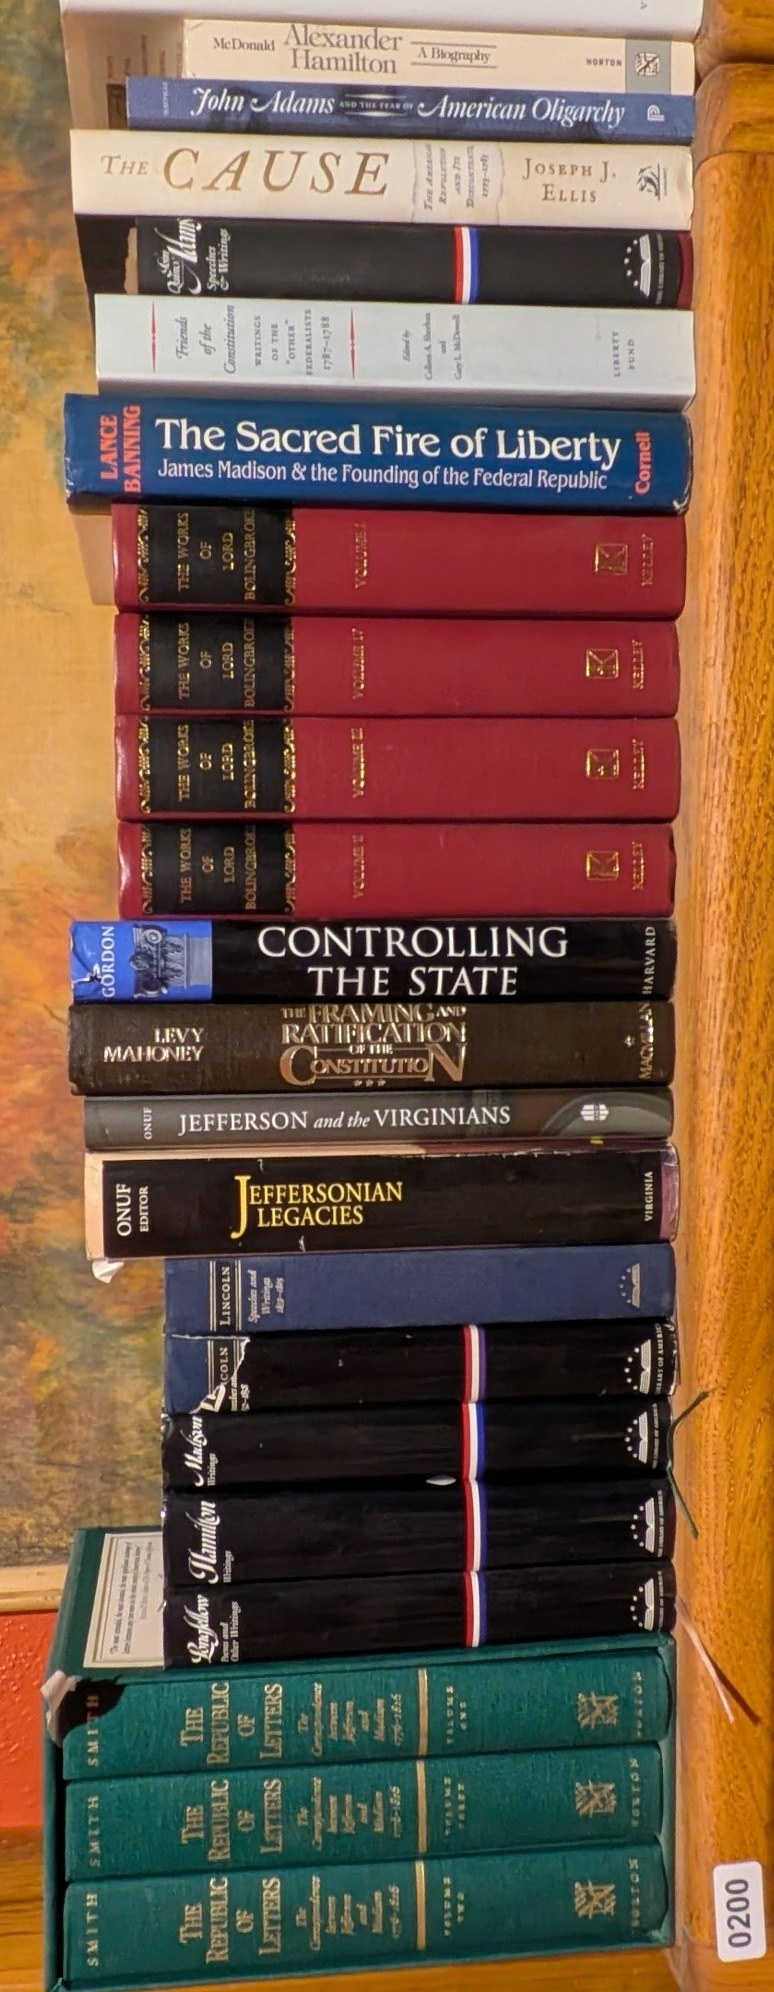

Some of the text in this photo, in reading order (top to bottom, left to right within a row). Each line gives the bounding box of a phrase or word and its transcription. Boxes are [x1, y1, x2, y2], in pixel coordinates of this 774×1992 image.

[213, 37, 276, 52] McDonald
[284, 23, 404, 51] Alexander
[418, 46, 491, 64] A Biography
[291, 48, 397, 74] Hamilton
[586, 58, 622, 67] NORTON
[191, 88, 336, 115] John Adams
[418, 94, 626, 128] American Oligarchy
[101, 148, 389, 195] THE CAUSE
[522, 158, 617, 183] JOSEPH J.
[542, 184, 598, 203] ELLIS
[205, 245, 220, 291] Speeches
[218, 228, 231, 274] Writings
[174, 316, 190, 360] Friends
[198, 324, 217, 356] of the
[222, 304, 237, 374] Constitution
[254, 314, 262, 368] WRITINGS
[270, 322, 279, 362] OF THE
[304, 308, 314, 376] FEDERALISTS
[611, 331, 620, 378] LIBERTY
[627, 338, 636, 370] FUND
[100, 414, 118, 480] LANCE
[123, 405, 141, 492] BANNING
[154, 418, 622, 470] The Sacred Fire of Liberty
[634, 431, 651, 494] Cornell
[158, 458, 608, 492] James Madison & the Founding of the Federal Republic
[176, 512, 190, 592] THE WORKS
[199, 540, 212, 560] OF
[222, 532, 234, 571] LORD
[354, 532, 367, 590] VOLUME
[641, 533, 654, 586] KELLEY
[177, 622, 190, 700] THE WORKS
[200, 650, 212, 670] OF
[222, 642, 234, 680] LORD
[352, 645, 364, 700] VOLUME
[632, 640, 644, 690] KELLEY
[177, 724, 190, 802] THE WORKS
[200, 752, 212, 771] OF
[222, 742, 234, 781] LORD
[352, 744, 364, 798] VOLUME
[632, 740, 644, 790] KELLEY
[180, 828, 192, 904] THE WORKS
[202, 855, 214, 873] OF
[224, 846, 235, 883] LORD
[352, 846, 364, 899] VOLUME
[632, 840, 644, 890] KELLEY
[101, 926, 115, 998] GORDON
[258, 926, 568, 958] CONTROLLING
[642, 926, 656, 995] HARVARD
[307, 966, 518, 996] THE STATE
[154, 1028, 204, 1044] LEVY
[280, 1003, 467, 1023] THE FRAMING AND
[280, 1022, 466, 1044] RATIFICATION
[103, 1045, 204, 1062] MAHONEY
[280, 1042, 467, 1086] CONSTITUTION
[349, 1044, 393, 1054] OF THE
[143, 1107, 152, 1140] ONUF
[178, 1106, 511, 1137] JEFFERSON and the VIRGINIANS
[116, 1184, 132, 1237] ONUF
[138, 1186, 150, 1232] EDITOR
[230, 1175, 403, 1239] JEFFERSONIAN
[257, 1205, 364, 1228] LEGACIES
[644, 1171, 654, 1222] VIRGINIA
[220, 1266, 231, 1326] LINCOLN
[185, 1500, 220, 1584] Hamilton
[182, 1594, 220, 1664] Longfellow
[86, 1694, 99, 1767] SMITH
[180, 1706, 204, 1748] THE
[206, 1682, 230, 1764] REPUBLIC
[237, 1712, 256, 1738] OF
[258, 1683, 282, 1760] LETTERS
[87, 1796, 100, 1868] SMITH
[181, 1805, 204, 1844] THE
[208, 1779, 230, 1861] REPUBLIC
[236, 1809, 256, 1832] OF
[260, 1778, 283, 1854] LETTERS
[86, 1893, 99, 1968] SMITH
[178, 1903, 203, 1944] THE
[205, 1876, 229, 1964] REPUBLIC
[236, 1909, 254, 1933] OF
[258, 1877, 282, 1955] LETTERS
[724, 1879, 752, 1948] 0200
